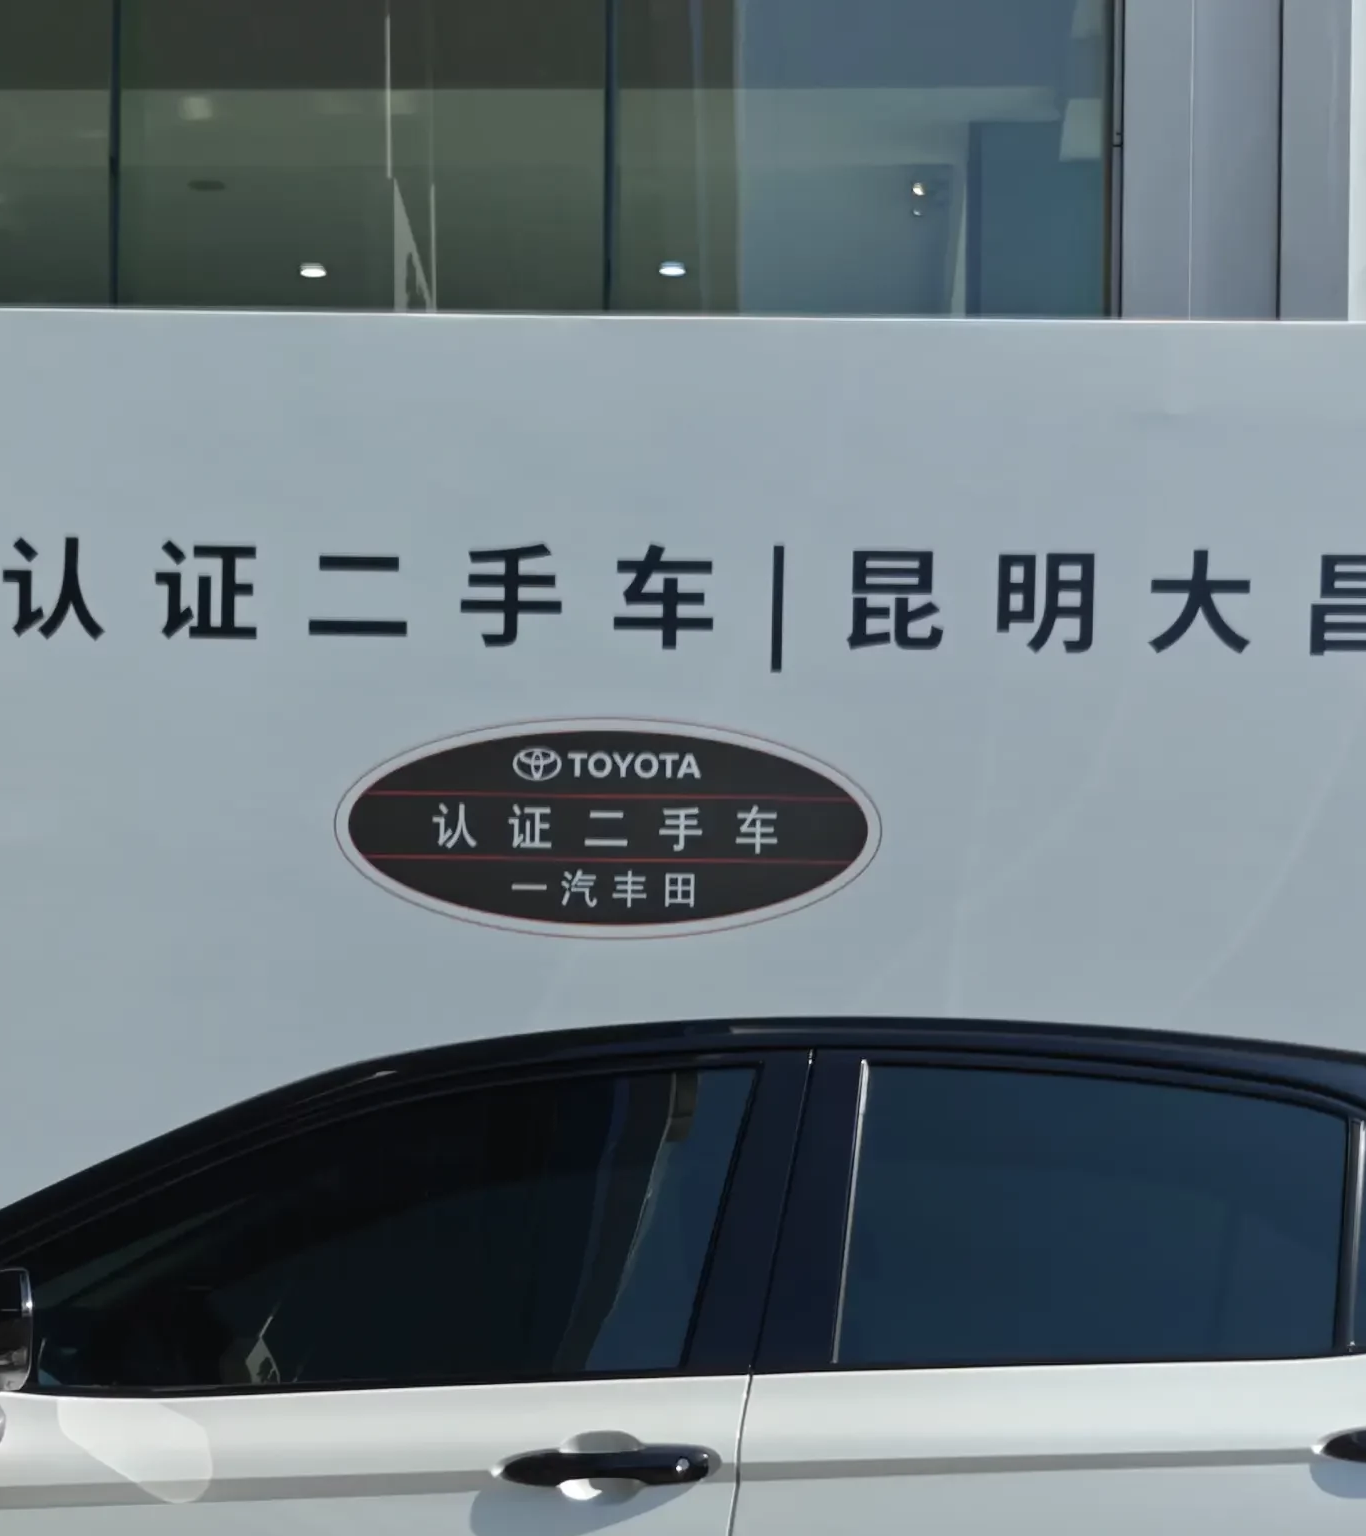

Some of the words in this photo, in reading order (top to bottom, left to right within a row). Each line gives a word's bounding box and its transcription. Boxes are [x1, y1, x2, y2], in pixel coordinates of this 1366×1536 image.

[568, 753, 700, 778] TOYOTA
[433, 804, 777, 854] 认证二手车
[512, 870, 694, 907] 一汽丰田
